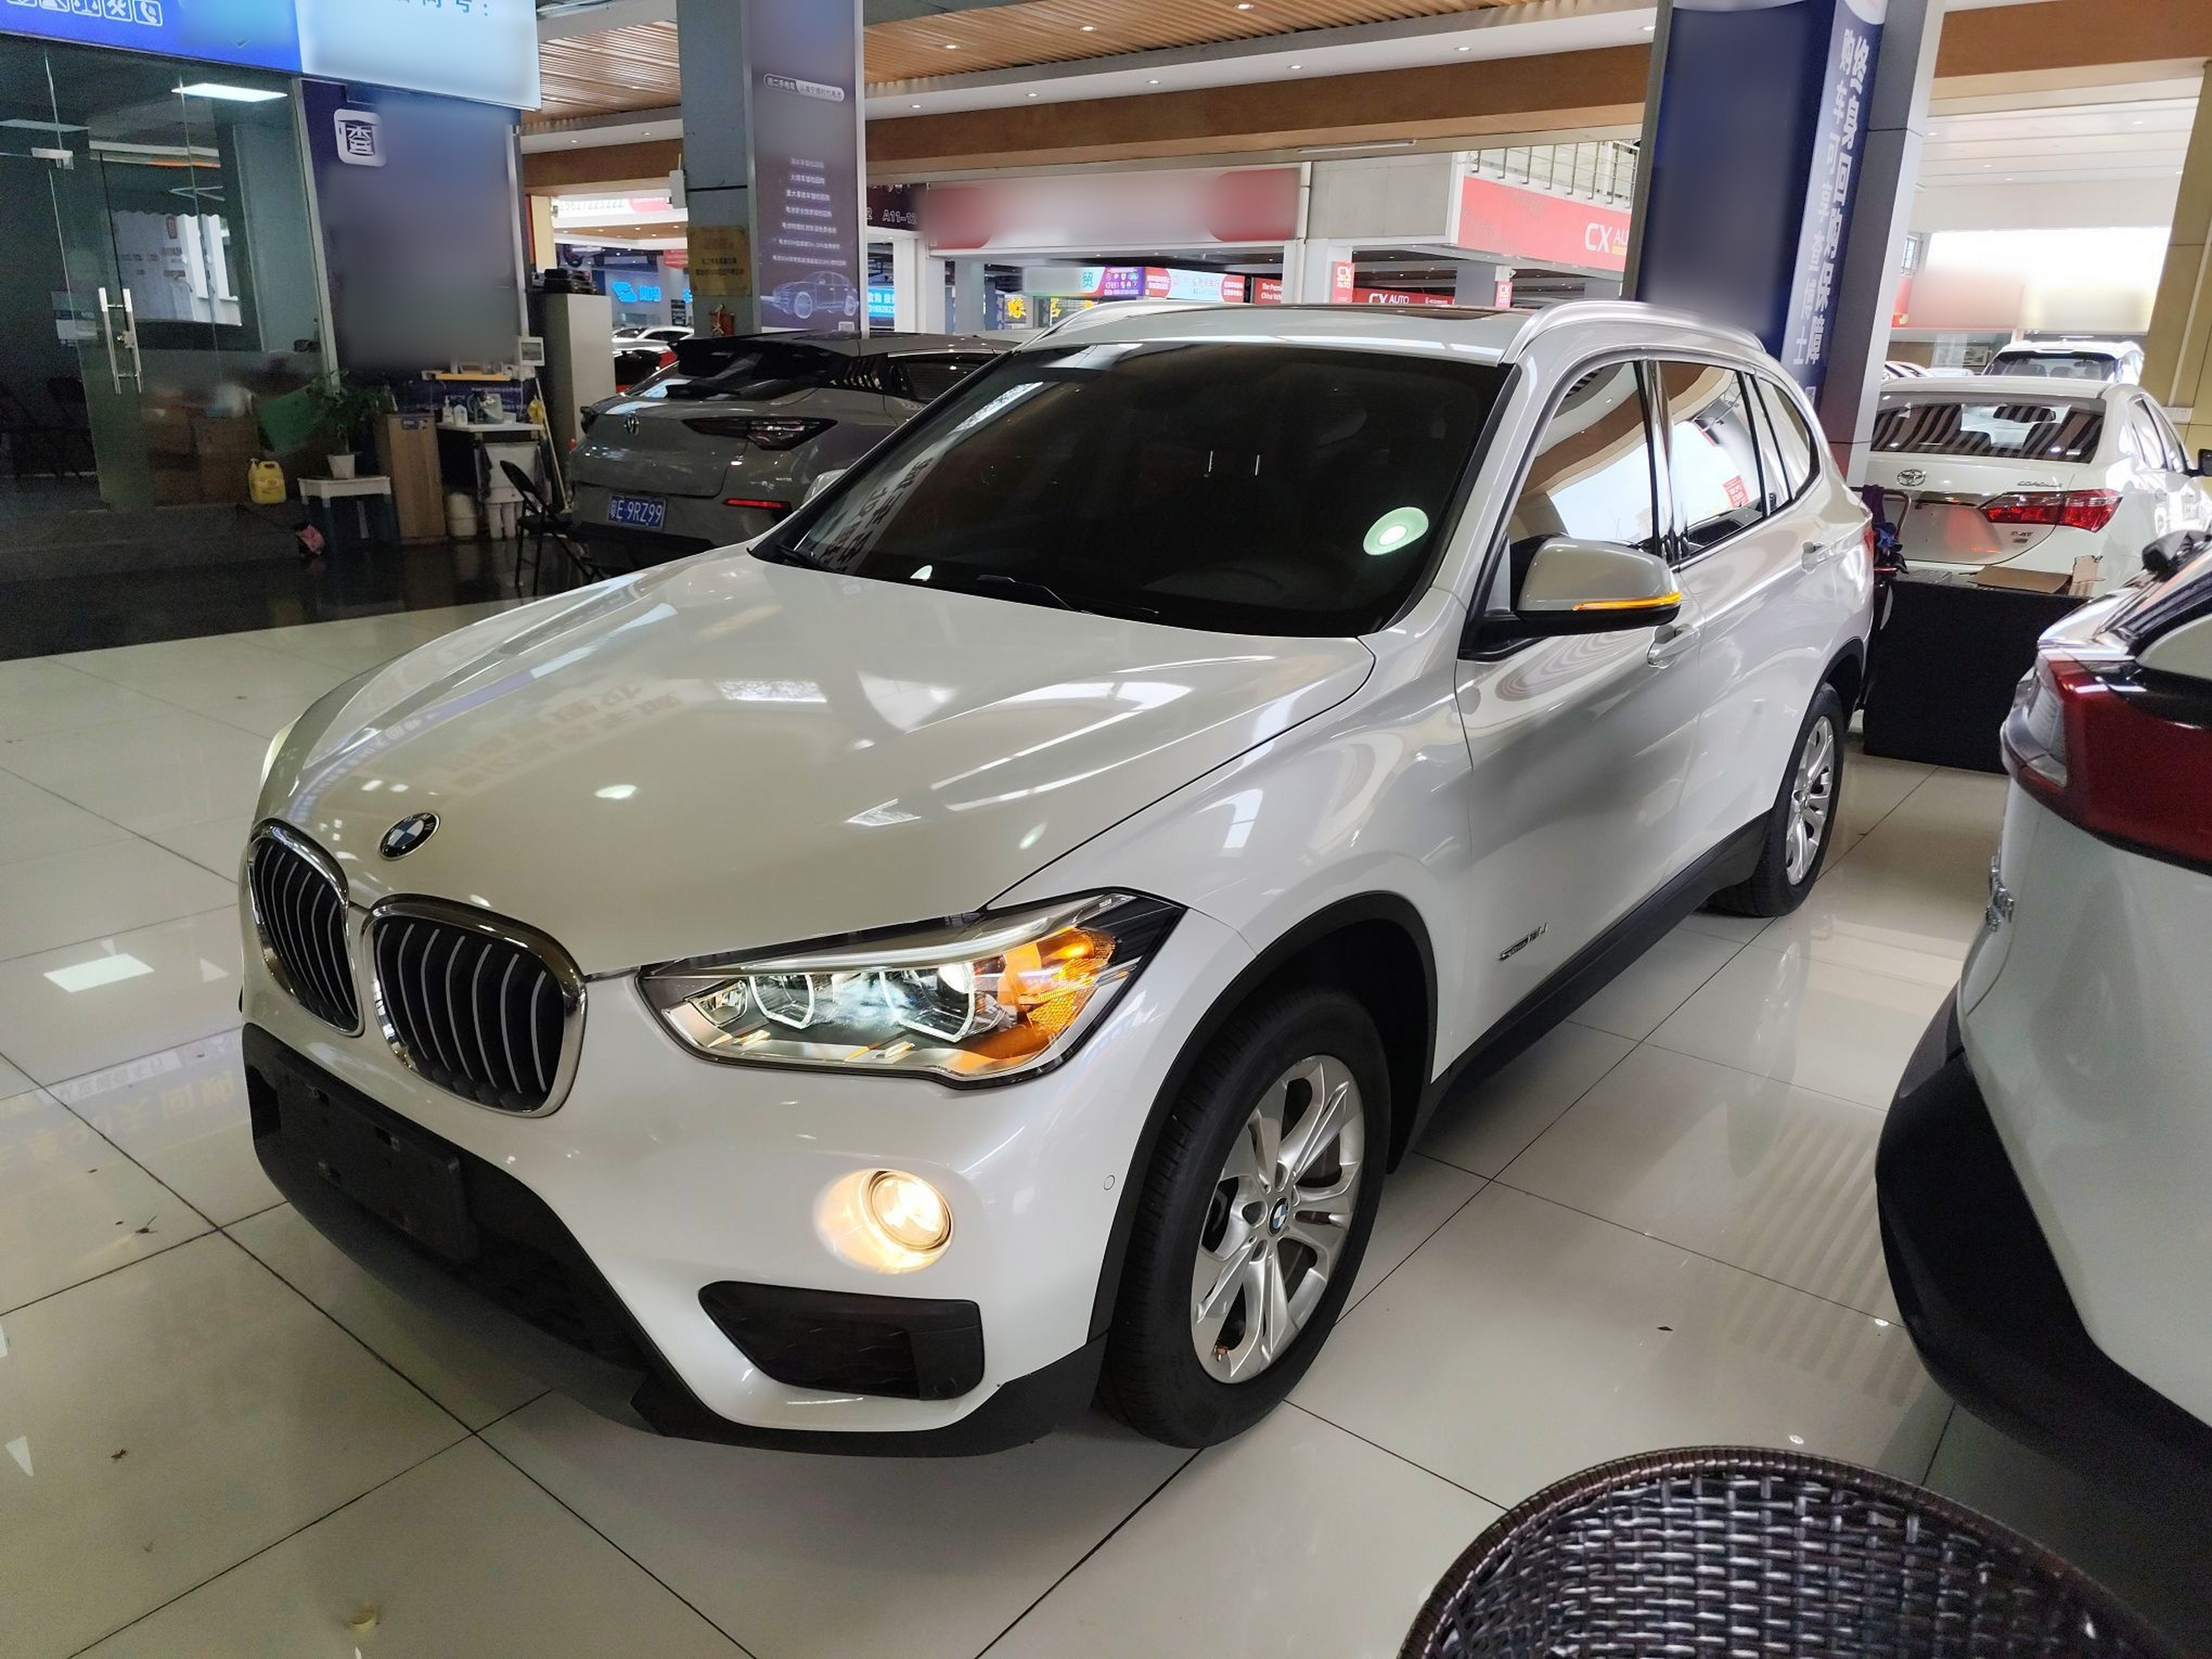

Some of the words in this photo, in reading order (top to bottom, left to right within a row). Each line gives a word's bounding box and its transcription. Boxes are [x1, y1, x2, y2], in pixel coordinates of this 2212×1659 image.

[882, 209, 917, 225] A11-12
[1585, 222, 1612, 253] CX
[1337, 266, 1352, 277] CX
[1388, 294, 1410, 304] AUTO
